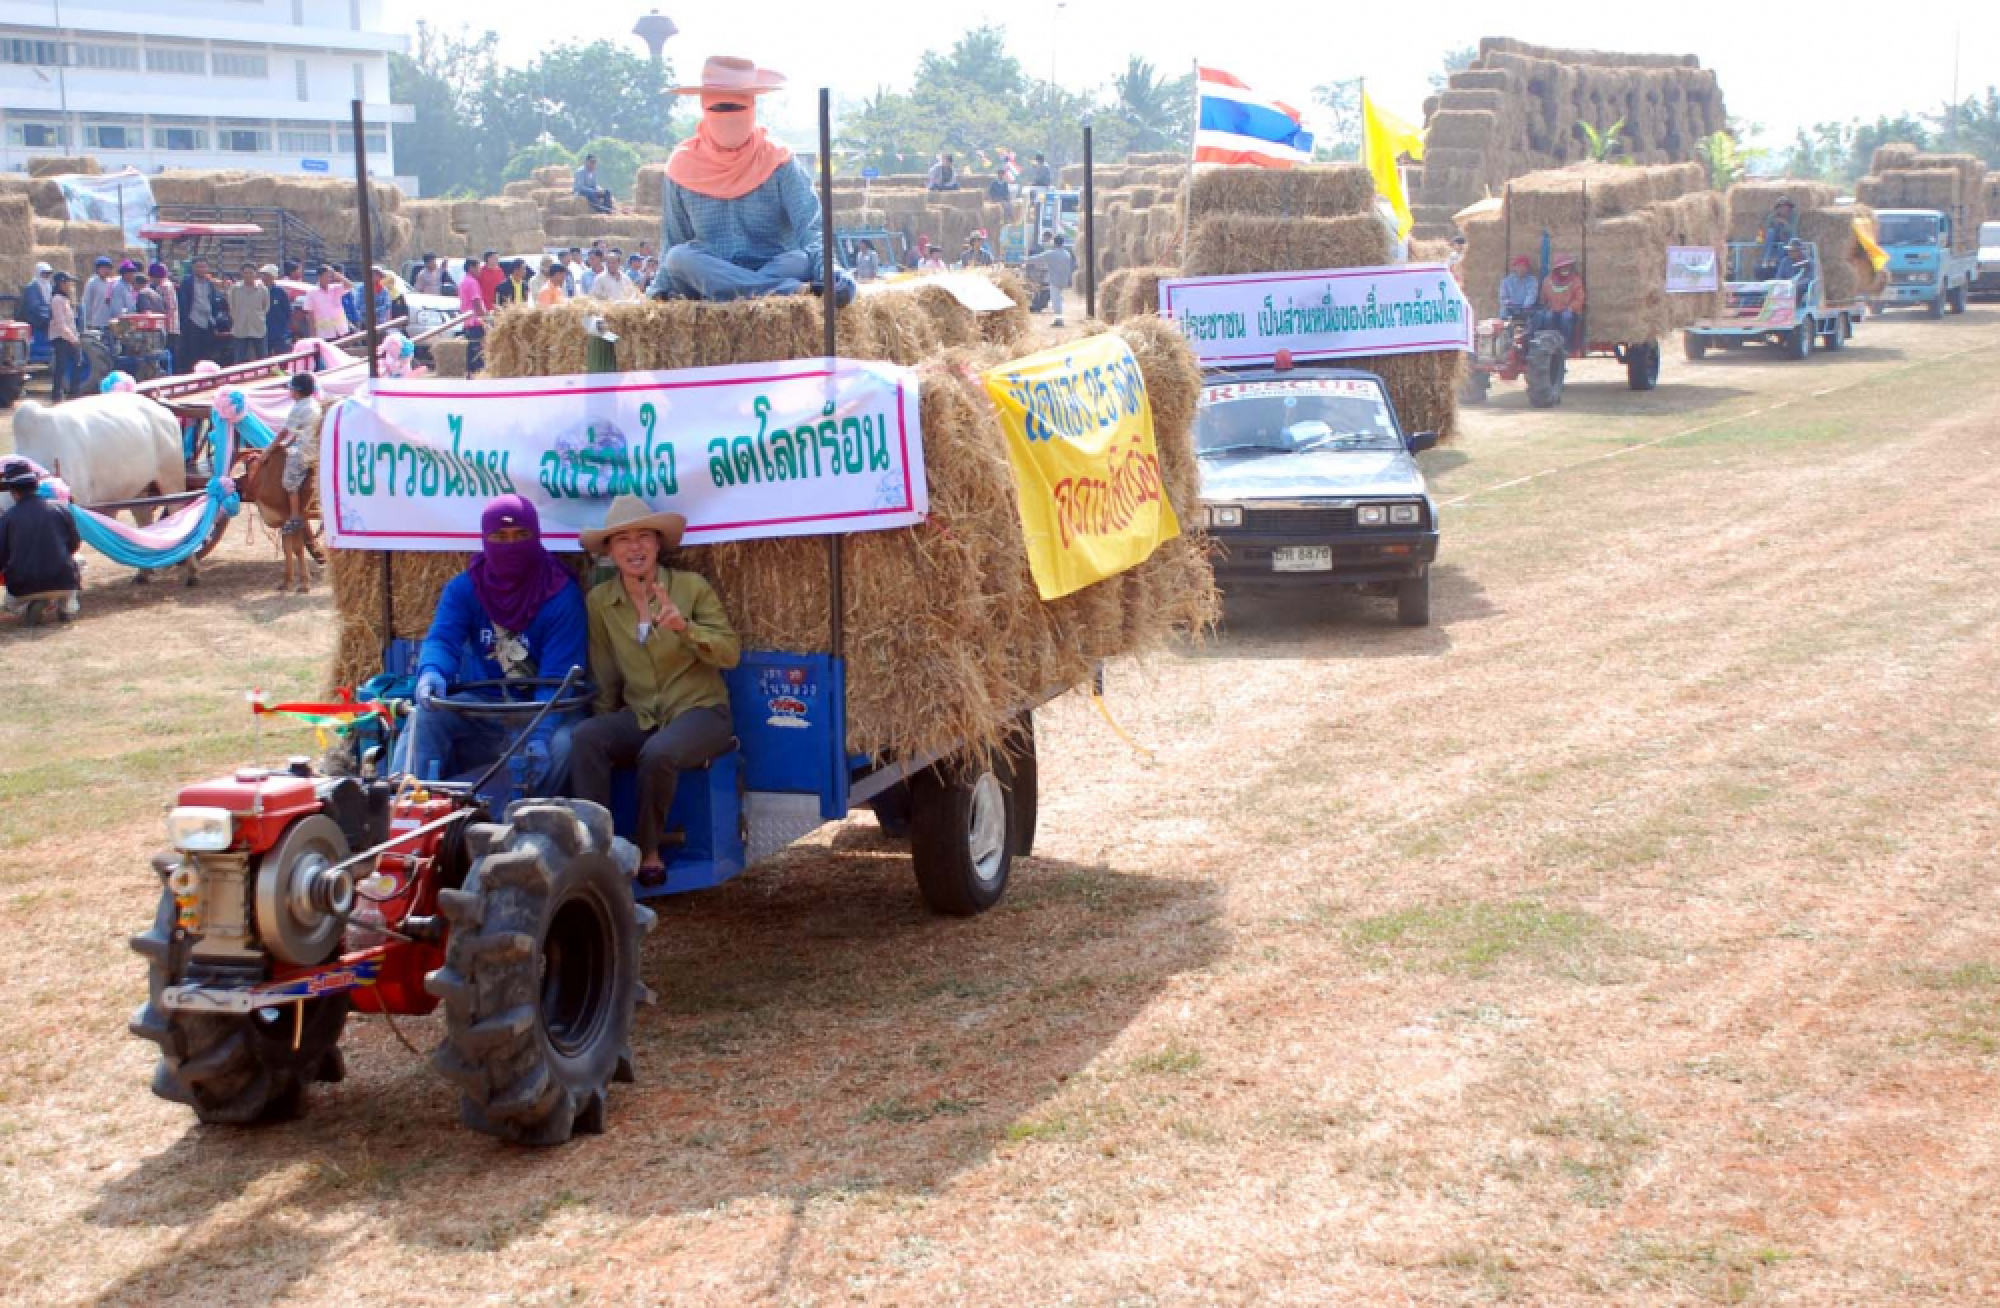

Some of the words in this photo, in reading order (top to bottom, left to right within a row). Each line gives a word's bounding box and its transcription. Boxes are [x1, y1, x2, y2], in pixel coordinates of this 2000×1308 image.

[345, 412, 517, 497] เยาวชนไทย
[707, 395, 890, 488] ลดโลกร้อน
